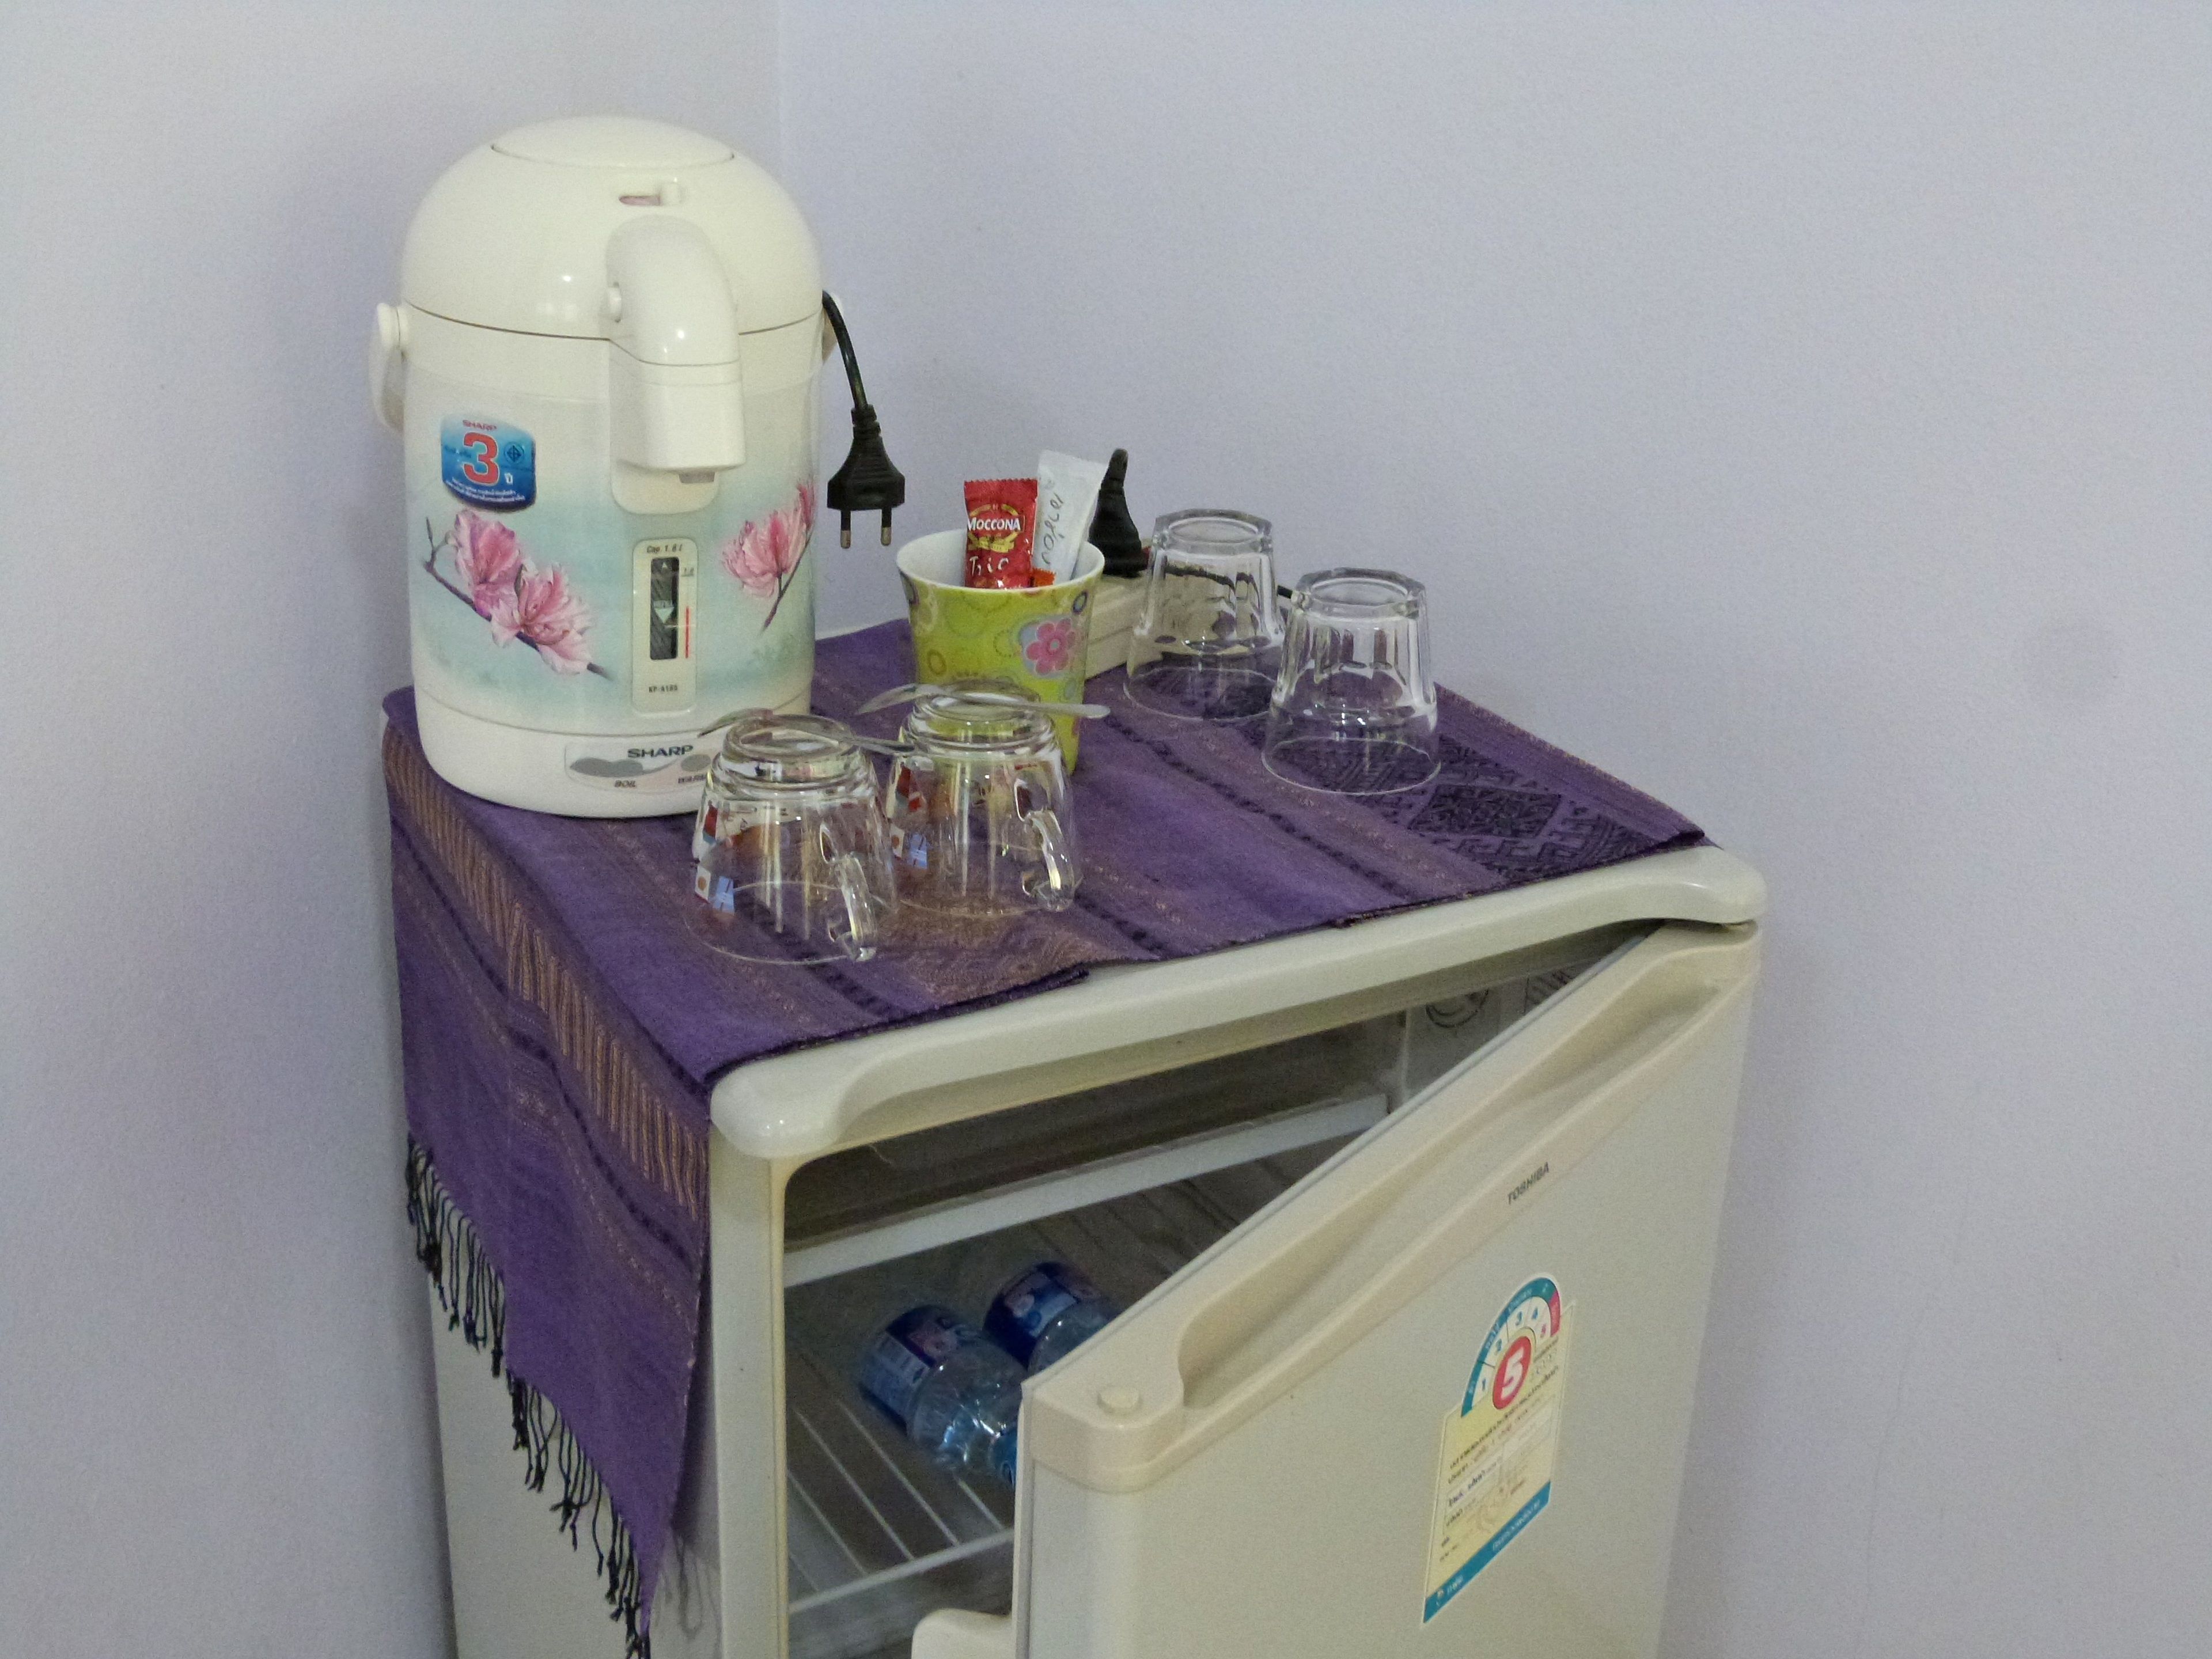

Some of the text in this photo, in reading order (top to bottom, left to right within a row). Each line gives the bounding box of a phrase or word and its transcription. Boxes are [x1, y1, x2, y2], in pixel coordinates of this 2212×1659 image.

[463, 431, 501, 487] 3
[967, 517, 1021, 532] MOCCONA
[627, 745, 694, 759] SHARP
